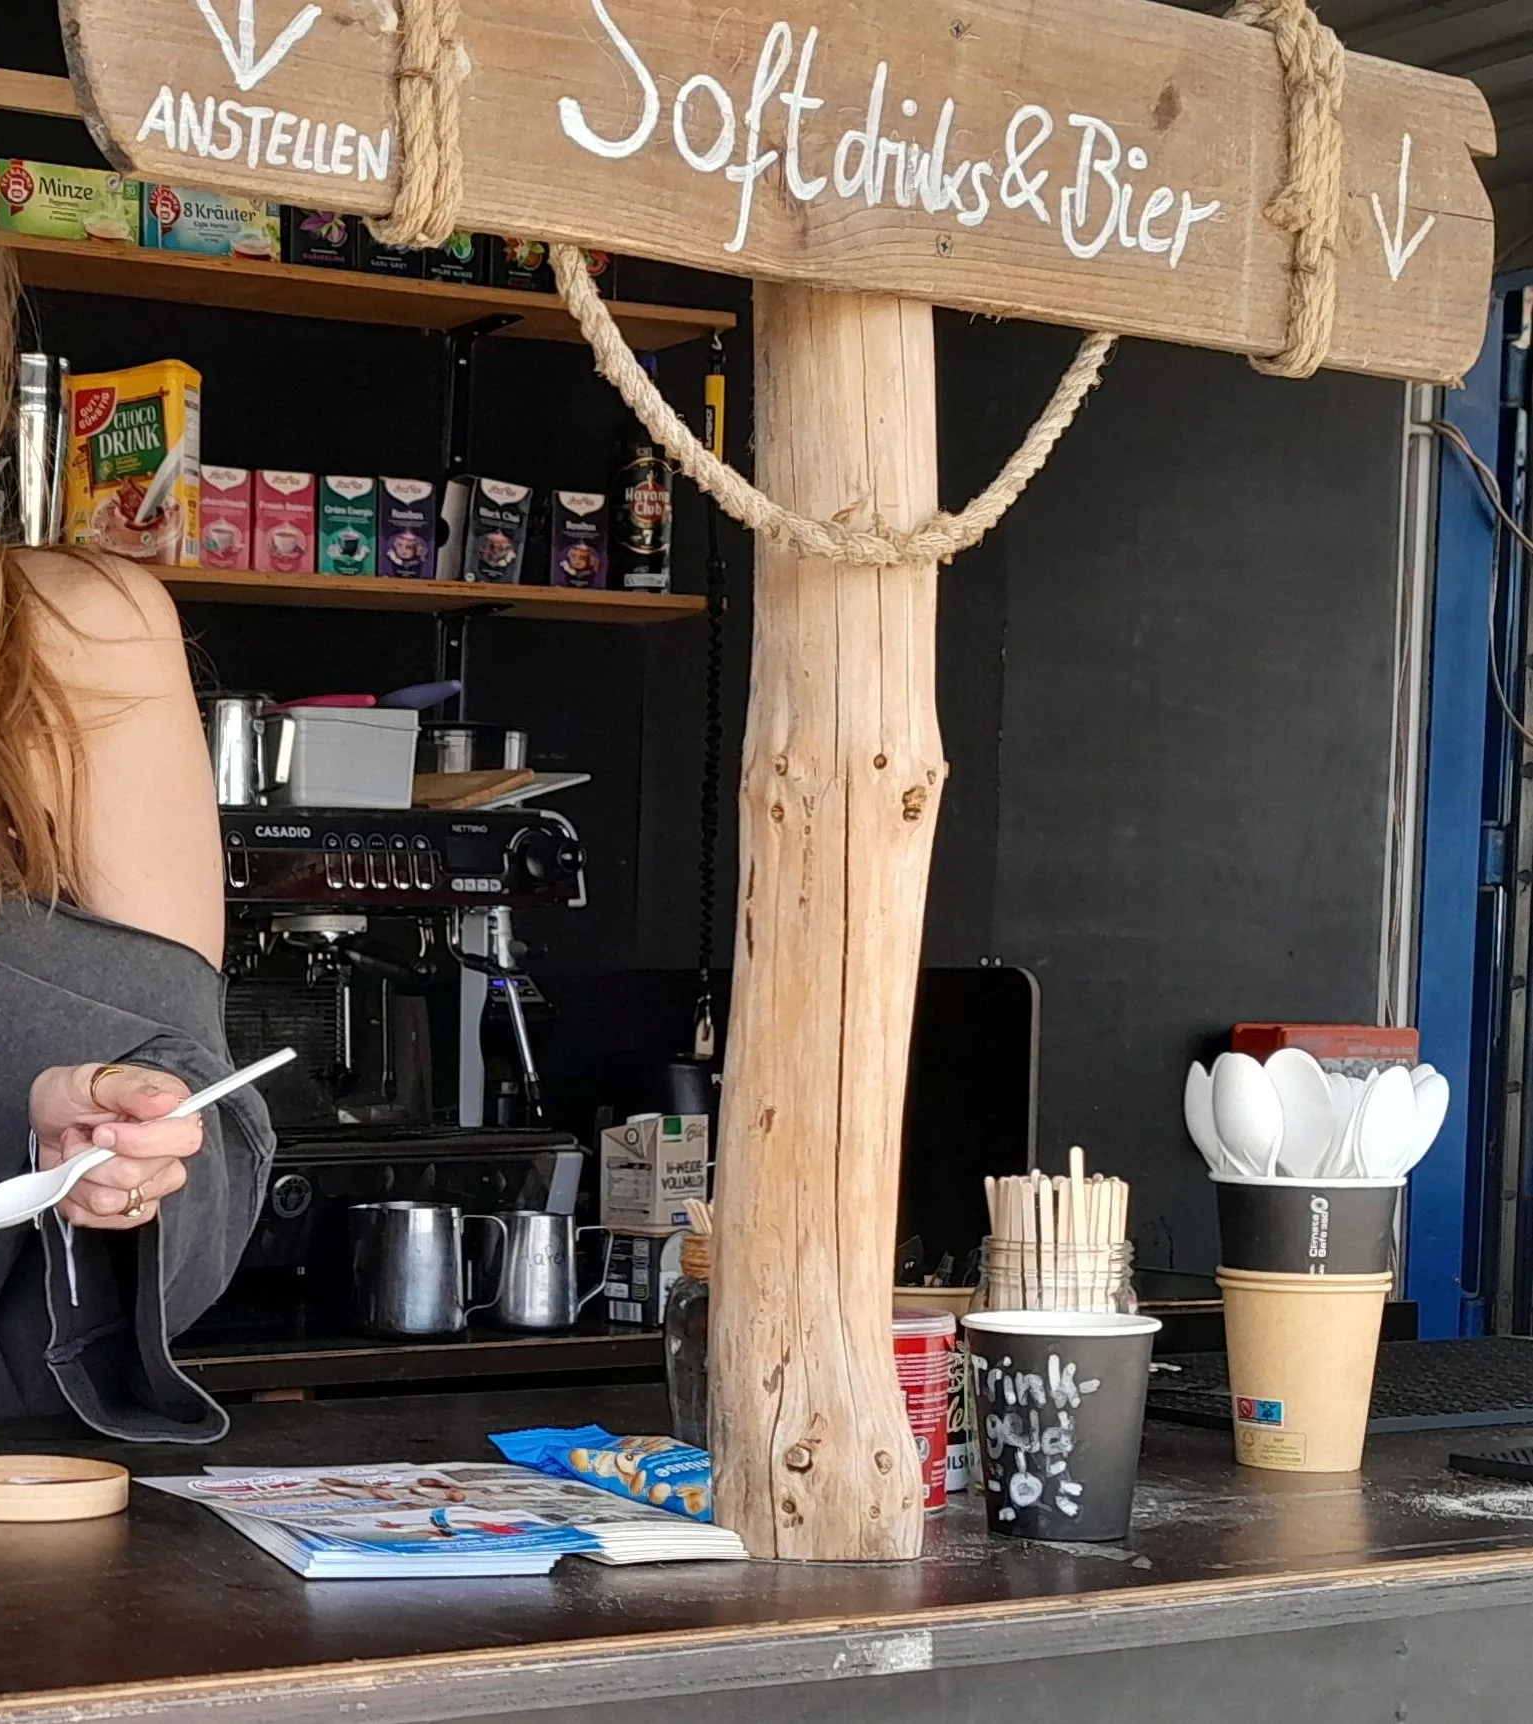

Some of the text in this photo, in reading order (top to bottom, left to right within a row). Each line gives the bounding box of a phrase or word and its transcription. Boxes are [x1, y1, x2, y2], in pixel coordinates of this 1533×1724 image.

[137, 85, 391, 182] ANSTELLEN
[38, 176, 94, 201] Minze
[999, 104, 1051, 223] &
[1062, 113, 1221, 268] Bier
[183, 202, 257, 222] 8 Kräuter
[113, 405, 157, 430] CHOCO
[98, 423, 162, 459] DRINK
[633, 502, 663, 516] Club
[254, 824, 312, 839] CASADIO
